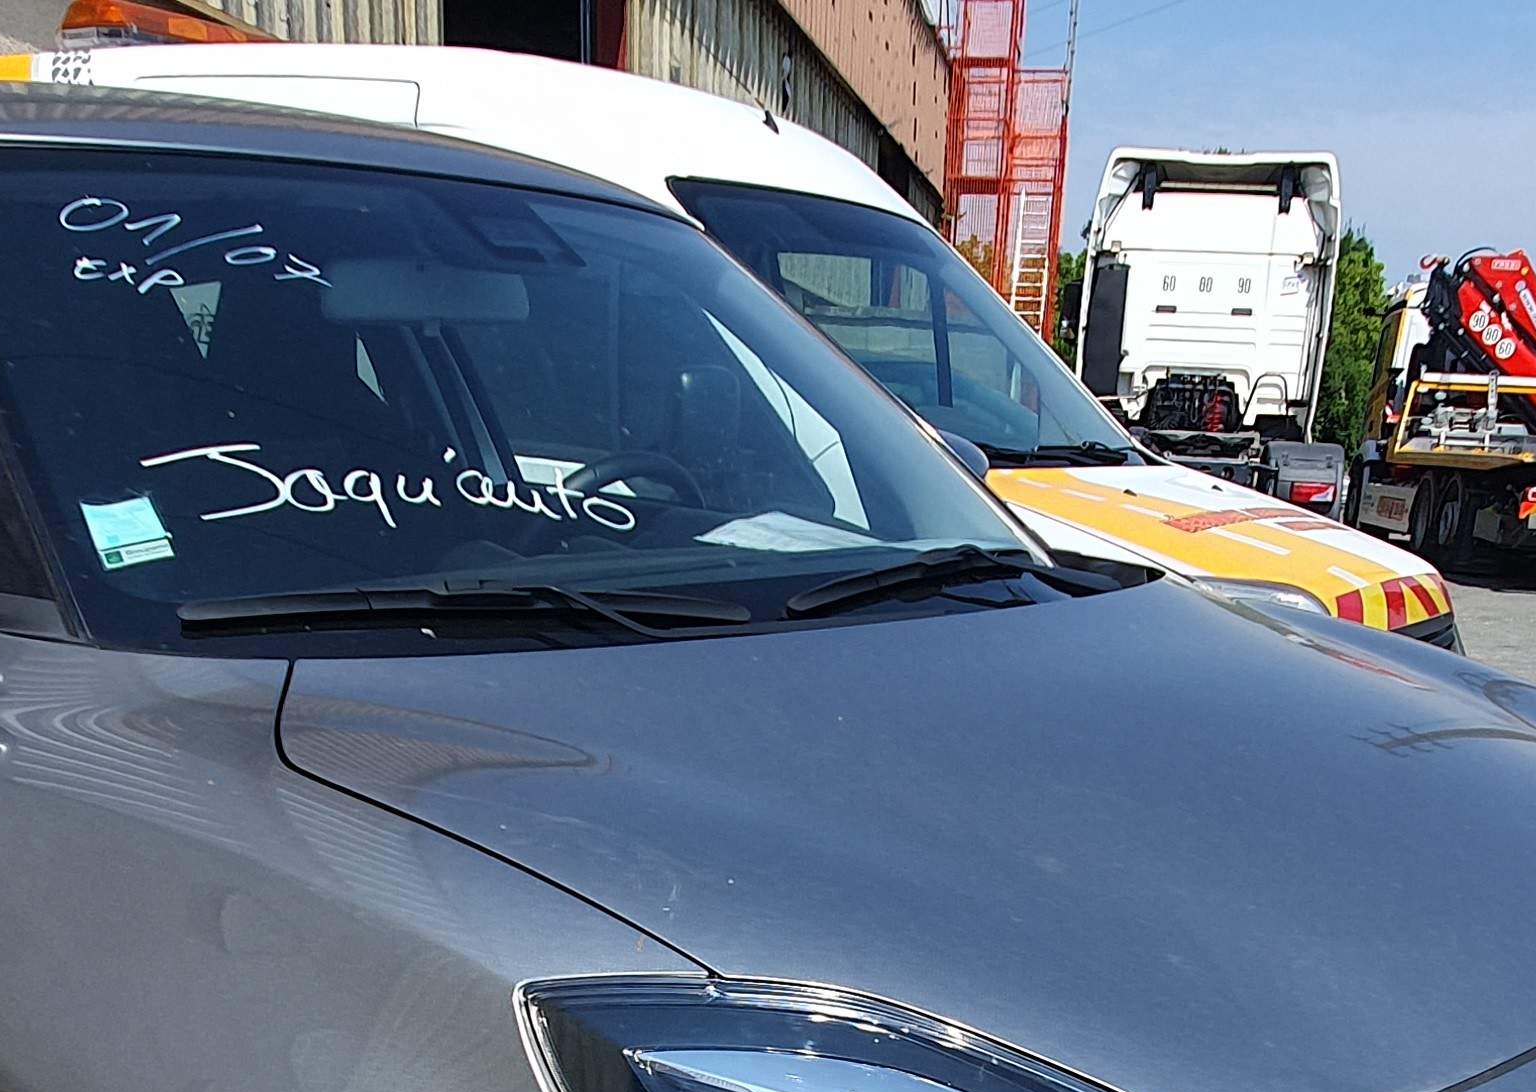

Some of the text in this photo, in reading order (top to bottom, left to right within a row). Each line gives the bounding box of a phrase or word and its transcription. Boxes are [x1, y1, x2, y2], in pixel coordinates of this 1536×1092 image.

[1162, 275, 1251, 294] 60 80 90
[1472, 314, 1513, 355] 90 80 60
